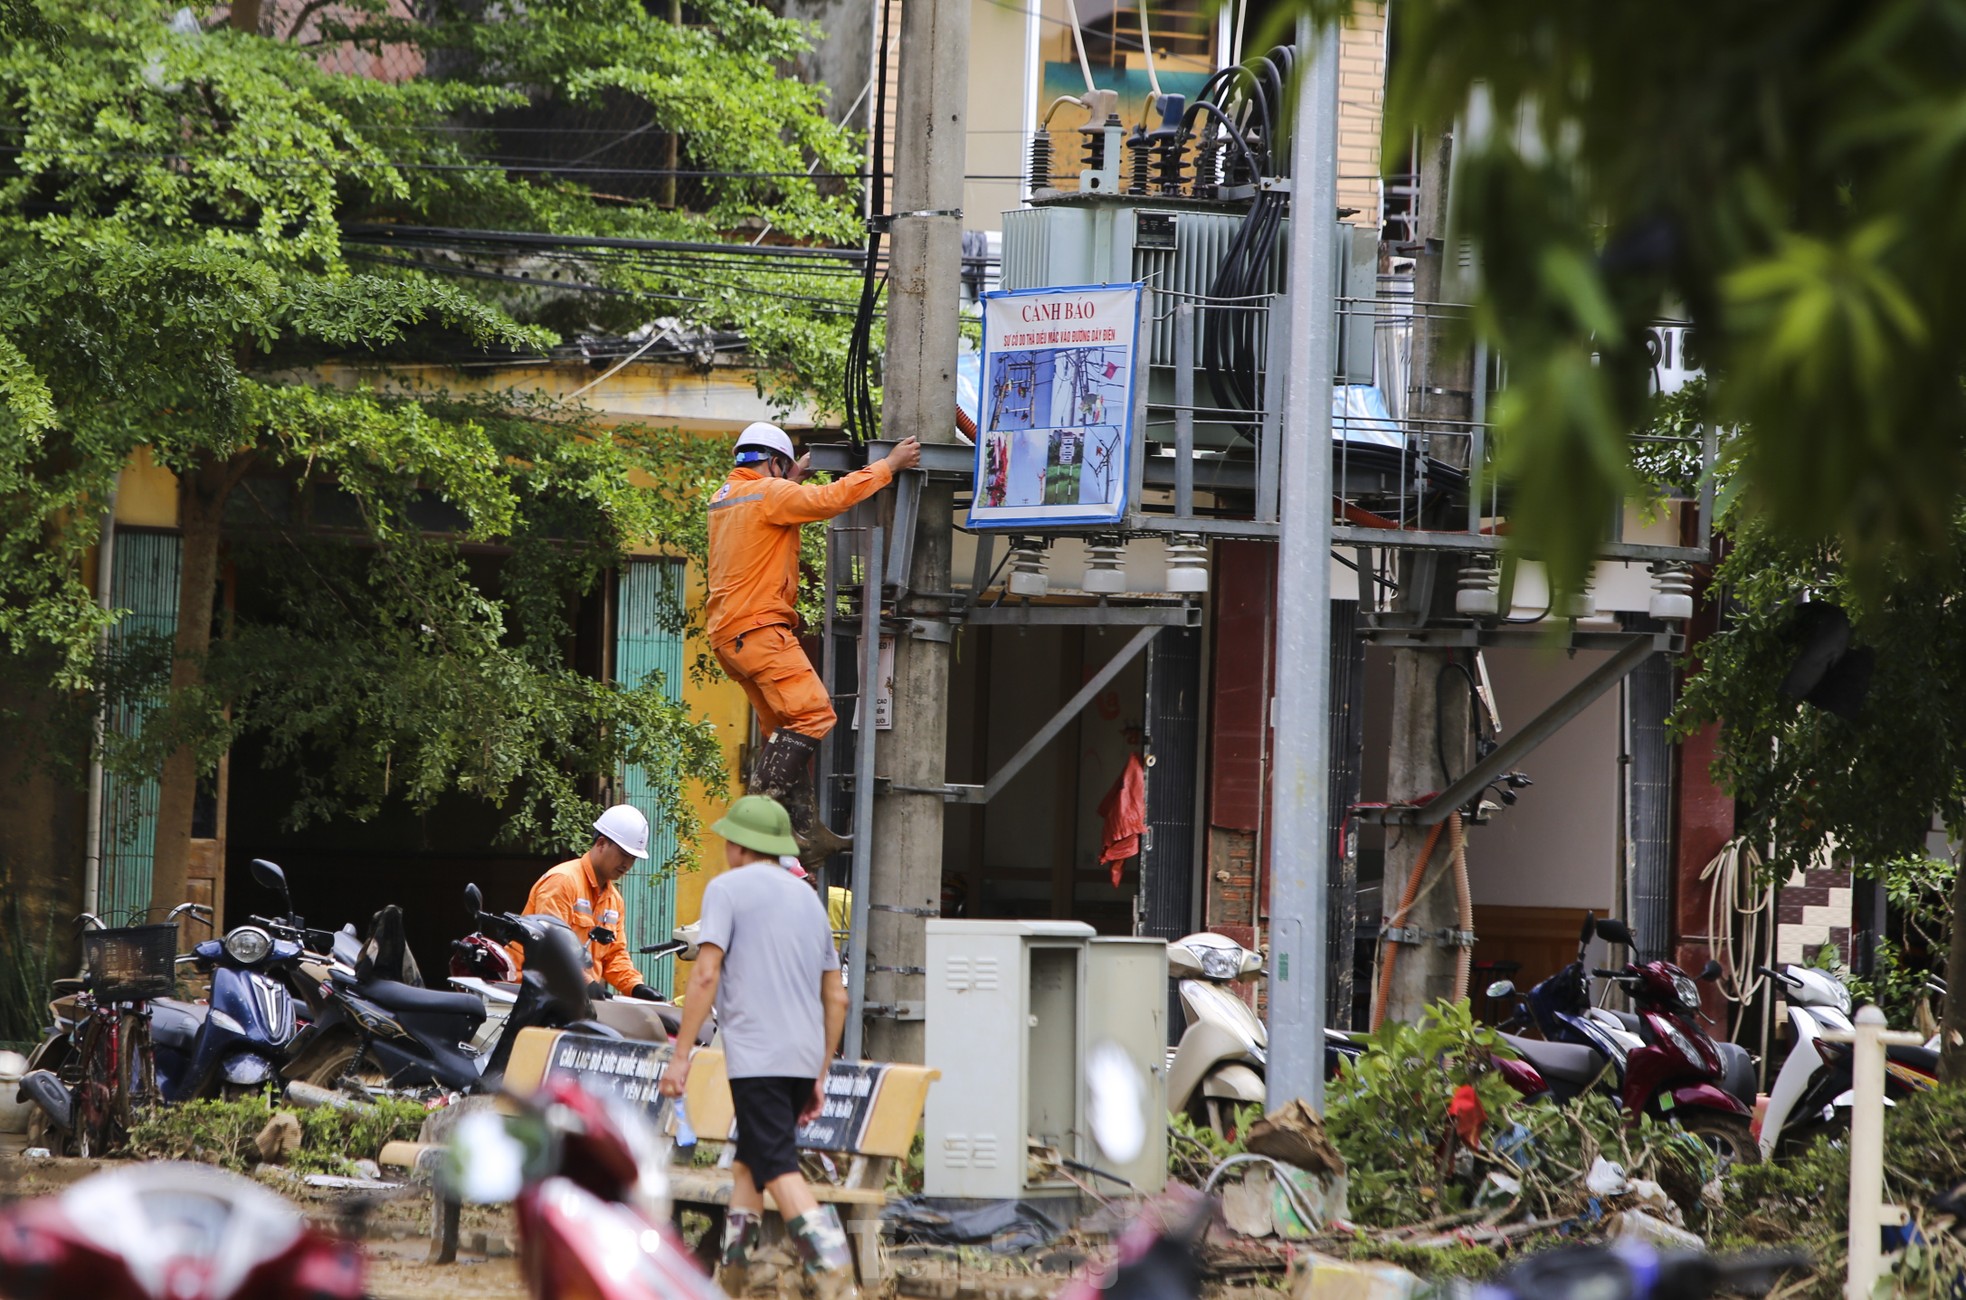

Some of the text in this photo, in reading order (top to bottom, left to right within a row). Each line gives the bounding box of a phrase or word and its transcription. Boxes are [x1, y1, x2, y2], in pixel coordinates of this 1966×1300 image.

[1022, 296, 1095, 323] CẢNH BÁO
[1019, 333, 1026, 346] DO
[1026, 329, 1035, 345] THẢ
[1060, 328, 1071, 343] VÀO
[559, 1045, 578, 1069] CÂU
[574, 1049, 592, 1073] LẠC
[588, 1048, 603, 1074] BỘ
[600, 1050, 618, 1074] SỨC
[623, 1079, 643, 1101] YÊN
[821, 1096, 837, 1118] ÊN
